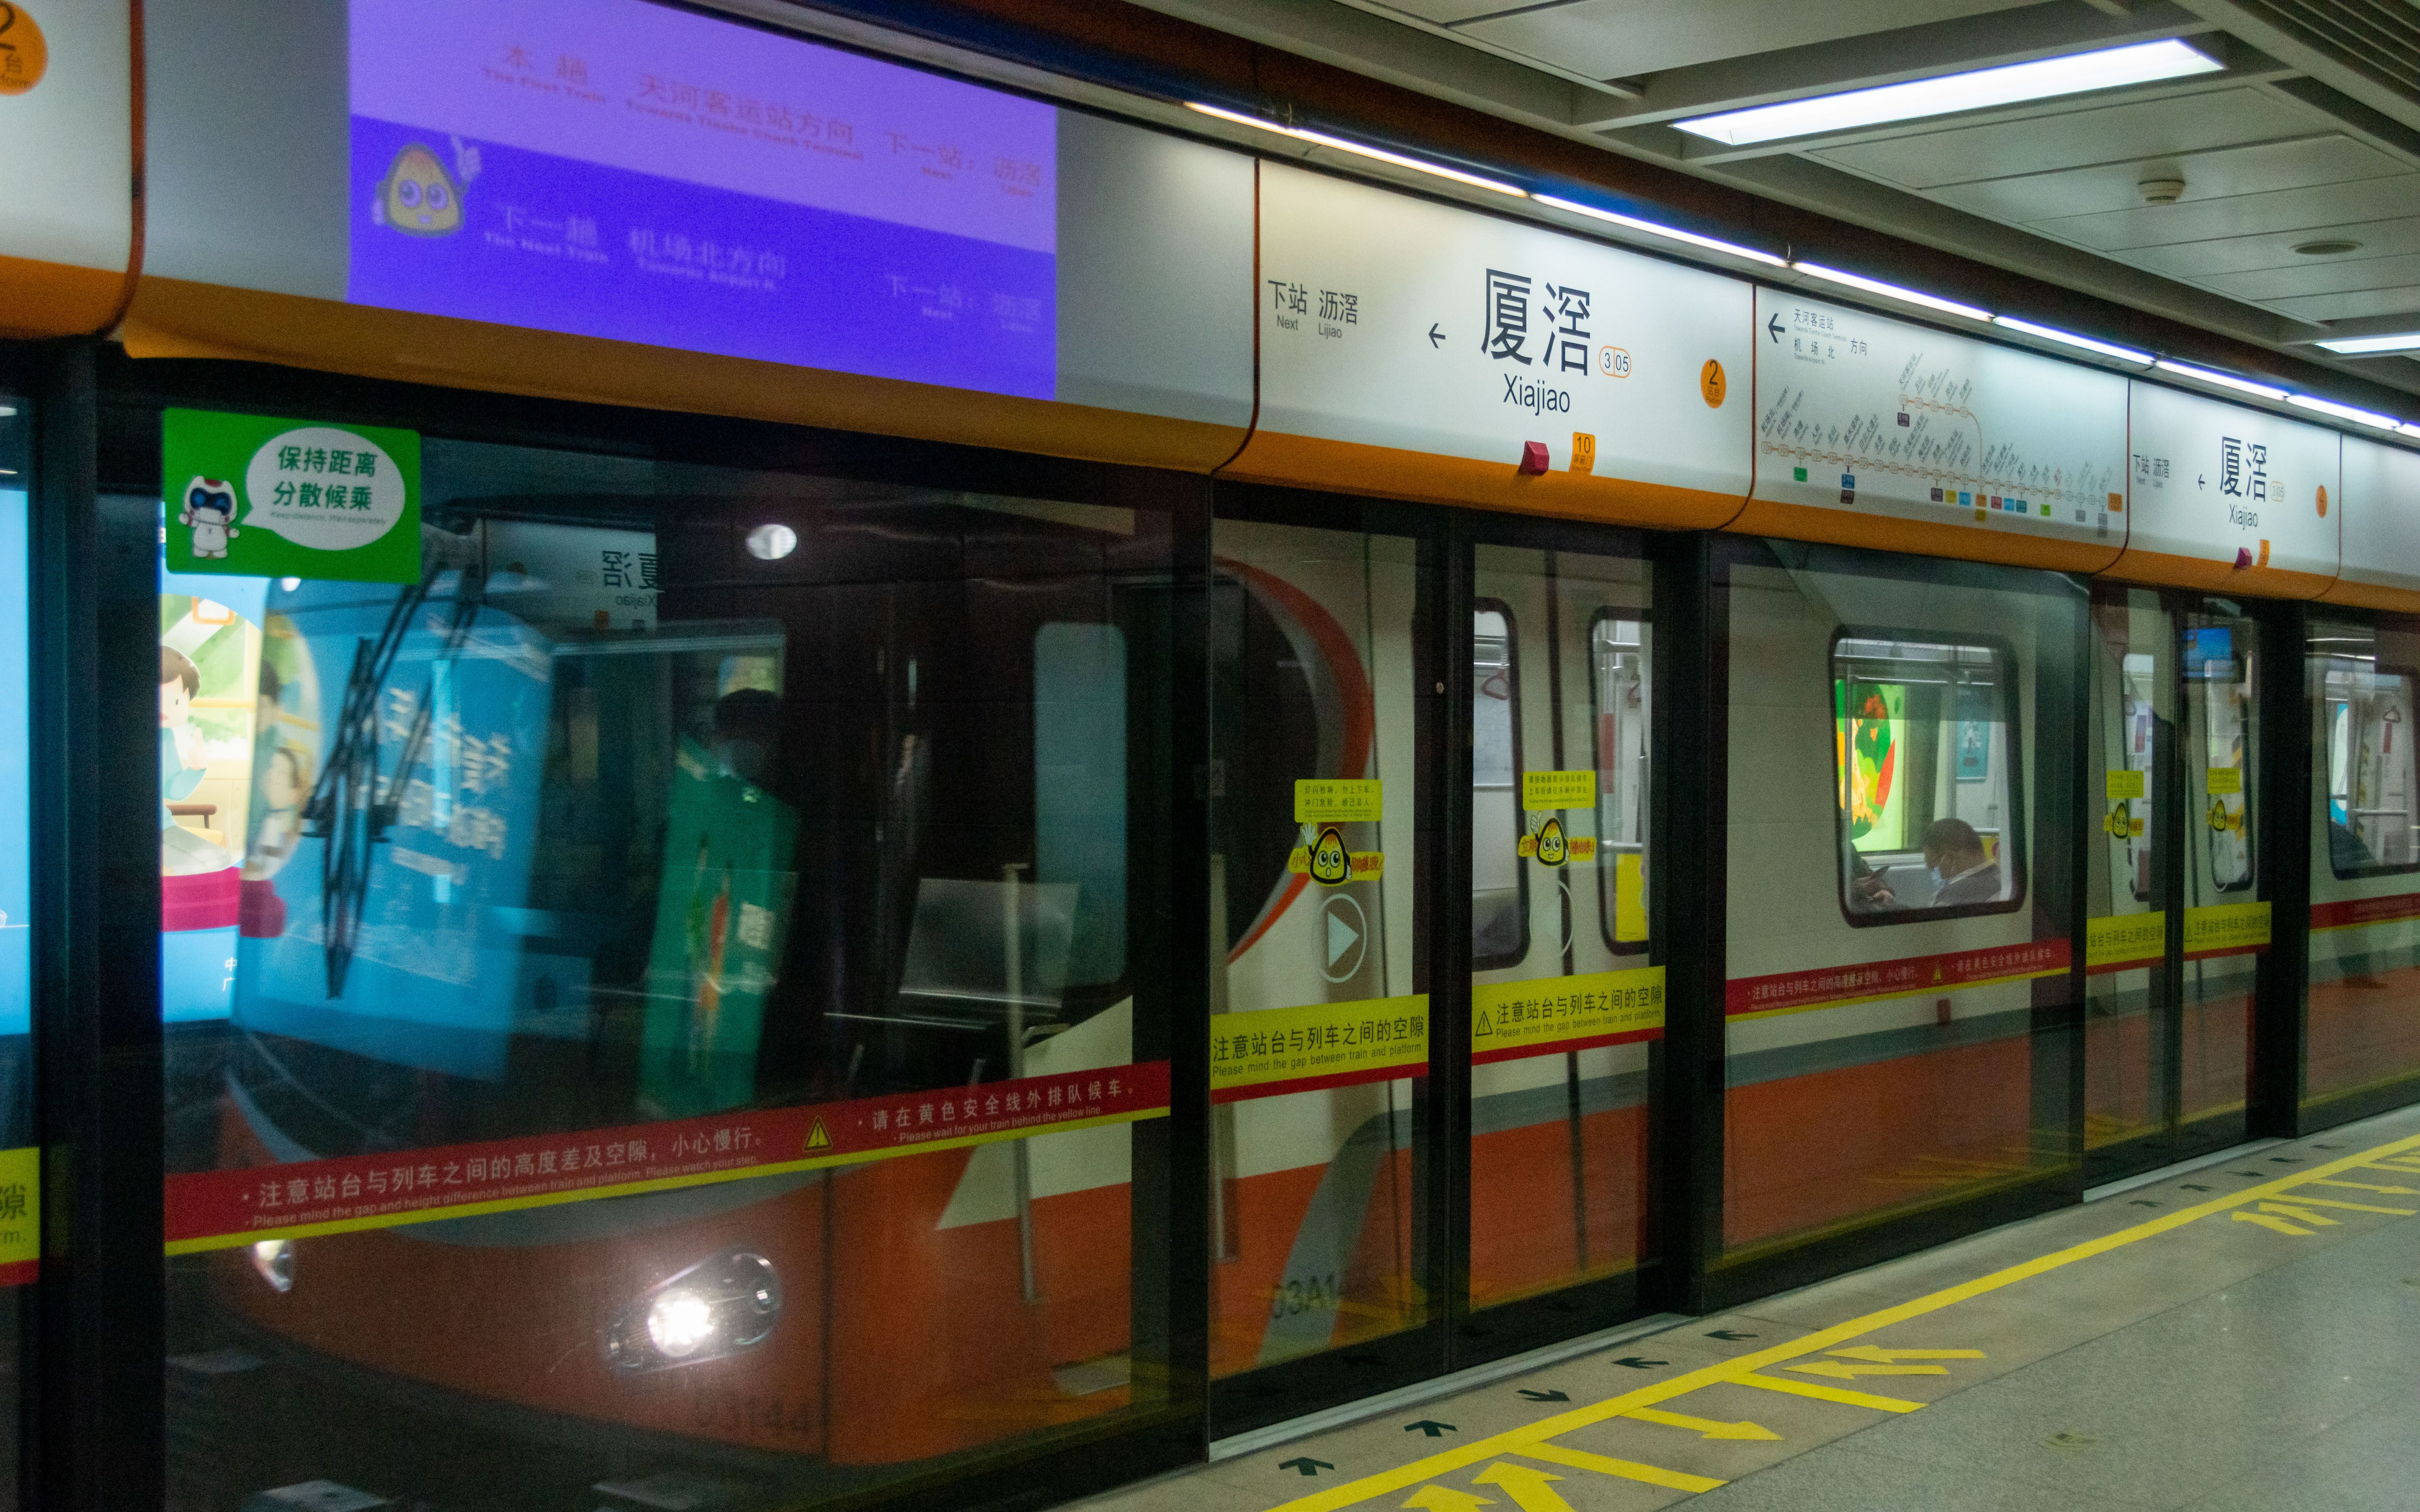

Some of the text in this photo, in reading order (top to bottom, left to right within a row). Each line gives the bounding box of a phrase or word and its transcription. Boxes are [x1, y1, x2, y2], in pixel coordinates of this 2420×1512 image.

[1268, 280, 1358, 325] 下站 沥滘
[1277, 314, 1342, 339] Next Lijiao
[1481, 268, 1591, 377] 厦滘
[1794, 308, 1834, 331] 天河客运站
[1604, 352, 1629, 372] 3 05
[1794, 337, 1867, 359] 机场北 方向
[1709, 360, 1718, 385] 2
[1503, 373, 1570, 417] Xiajiao
[1577, 436, 1590, 454] 10
[278, 445, 378, 477] 保持距离
[2133, 454, 2149, 475] 下站
[2220, 436, 2267, 502] 厦滘
[273, 481, 373, 511] 分散候乘
[2229, 504, 2258, 531] Xiajiao
[1496, 985, 1663, 1025] 注意站台与列车之间的空隙
[1213, 1015, 1425, 1062] 注意站台与列车之间的空隙
[1496, 1027, 1521, 1038] Please
[1523, 1023, 1540, 1034] mind
[1543, 1021, 1554, 1032] the
[1557, 1020, 1570, 1031] gap
[1573, 1015, 1601, 1029] between
[1603, 1013, 1618, 1025] train
[1620, 1011, 1632, 1022] and
[1212, 1065, 1243, 1078] Please
[1248, 1060, 1270, 1073] mind
[1273, 1058, 1287, 1070] the
[1291, 1056, 1307, 1070] gap
[1310, 1051, 1346, 1065] between
[1349, 1048, 1368, 1060] train
[1371, 1046, 1387, 1058] and
[899, 1130, 932, 1143] Please
[933, 1126, 953, 1139] wait
[954, 1125, 966, 1137] for
[968, 1121, 988, 1136] your
[990, 1118, 1009, 1131] train
[1011, 1113, 1041, 1128] behind
[1042, 1112, 1057, 1125] the
[1058, 1107, 1085, 1123] yellow
[252, 1214, 296, 1229] Please
[300, 1210, 330, 1225] mind
[332, 1207, 352, 1220] the
[354, 1206, 377, 1221] gap
[380, 1200, 401, 1214] and
[404, 1194, 440, 1211] height
[443, 1188, 499, 1205] difference
[502, 1182, 547, 1196] between
[550, 1177, 575, 1191] train
[577, 1175, 596, 1188] and
[646, 1166, 681, 1179] Please
[683, 1161, 711, 1173] watch
[712, 1158, 734, 1171] your
